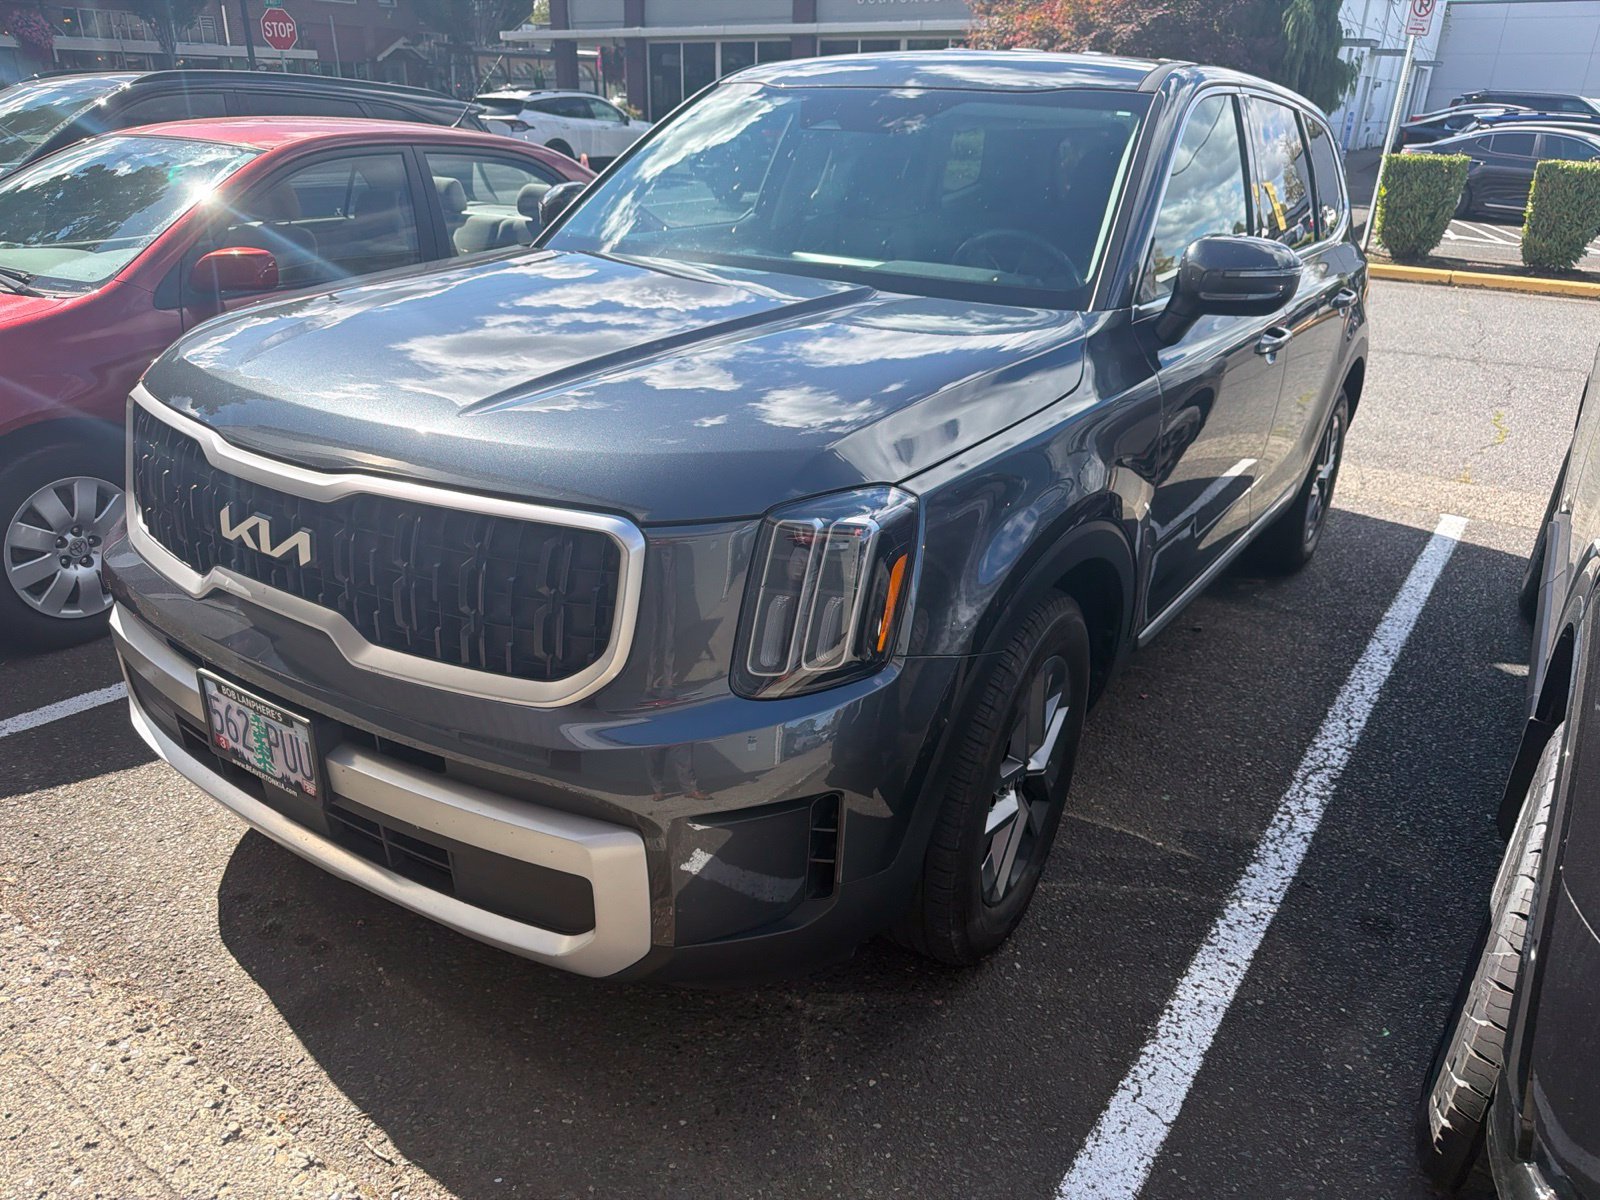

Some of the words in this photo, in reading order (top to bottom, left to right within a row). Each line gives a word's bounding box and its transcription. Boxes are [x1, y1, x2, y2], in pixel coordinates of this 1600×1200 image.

[264, 21, 294, 38] STOP
[220, 505, 311, 567] KIA
[221, 685, 236, 700] BOB
[236, 693, 283, 722] LANPHERE'S
[208, 693, 255, 753] 562
[265, 722, 314, 781] PUU
